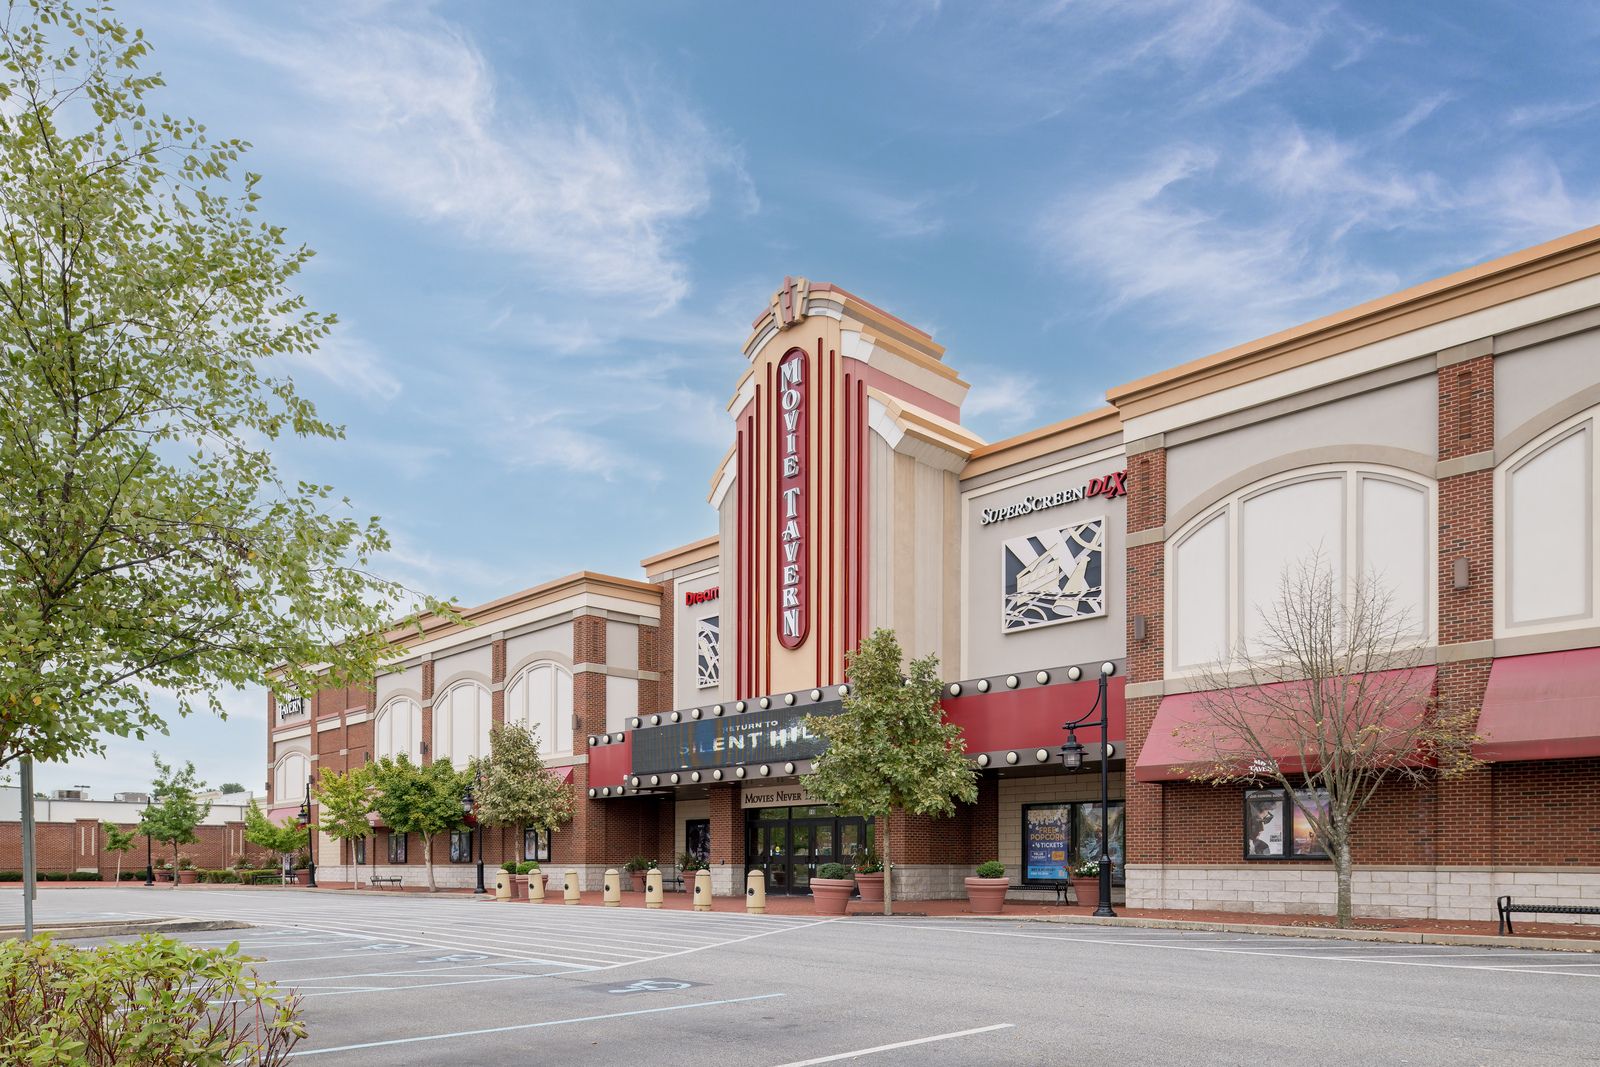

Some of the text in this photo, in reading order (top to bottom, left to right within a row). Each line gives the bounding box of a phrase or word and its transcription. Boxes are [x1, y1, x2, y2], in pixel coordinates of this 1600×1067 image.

[1086, 469, 1127, 500] DLX
[780, 358, 802, 638] MOVIE TAVERN
[765, 720, 778, 728] TO
[745, 793, 774, 804] MOVIES
[776, 790, 802, 802] NEVER
